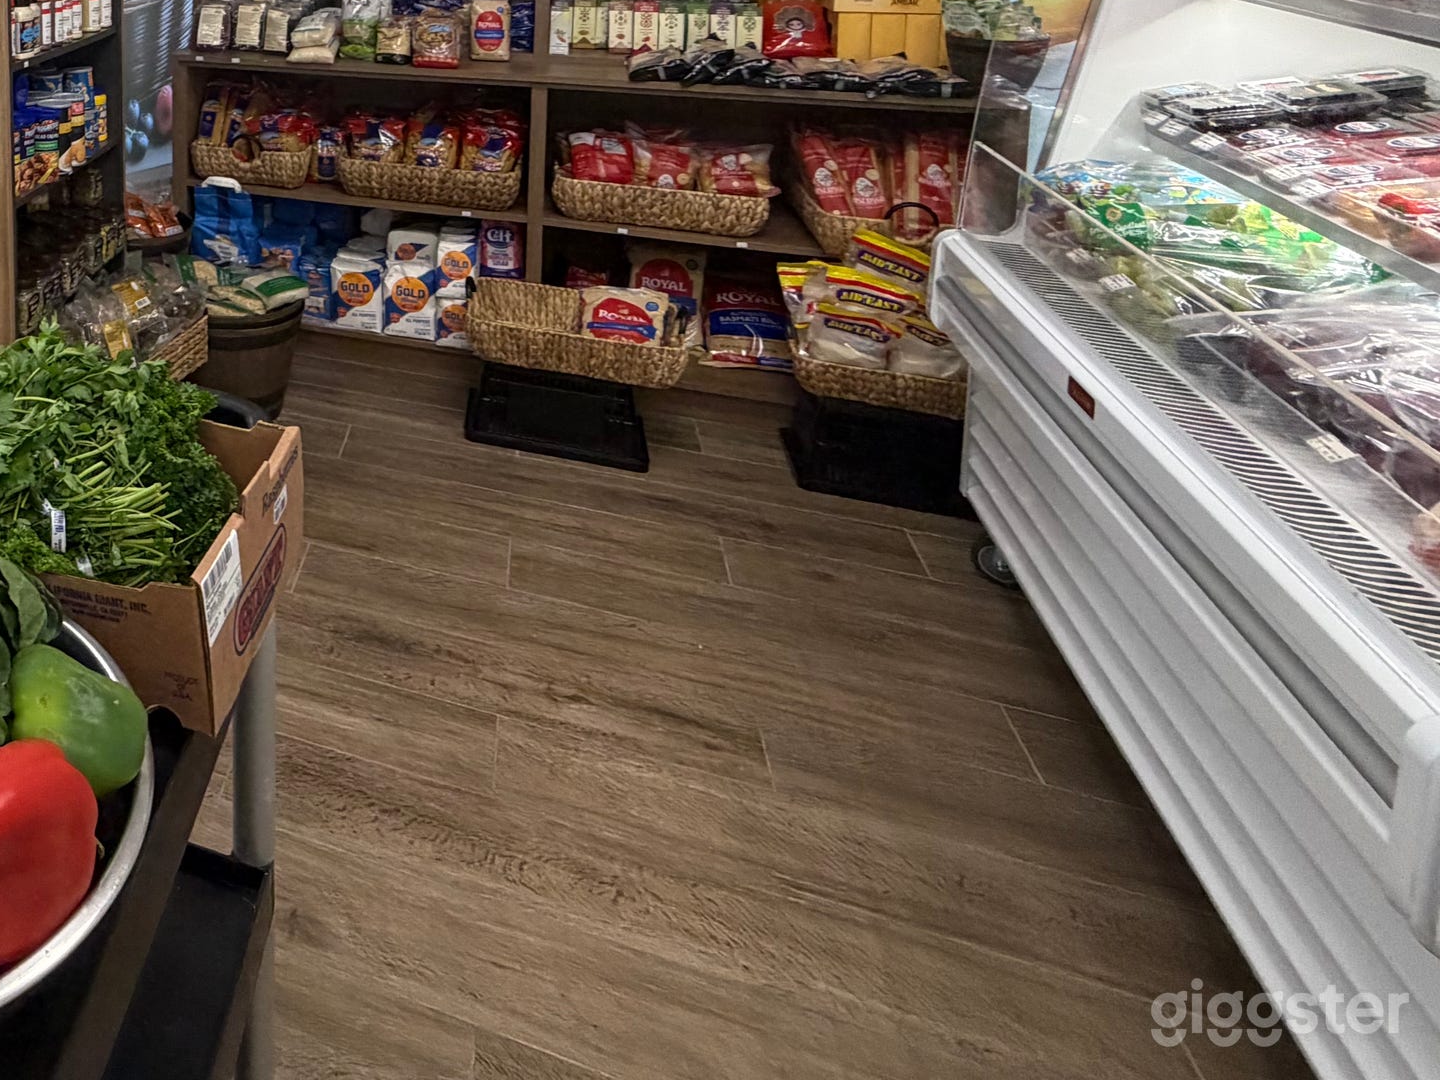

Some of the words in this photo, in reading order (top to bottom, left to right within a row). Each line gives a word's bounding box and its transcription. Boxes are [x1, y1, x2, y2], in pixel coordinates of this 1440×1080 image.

[444, 259, 469, 269] GOLD
[340, 280, 370, 293] GOLD
[641, 276, 688, 292] ROYAL
[396, 285, 425, 298] GOLD
